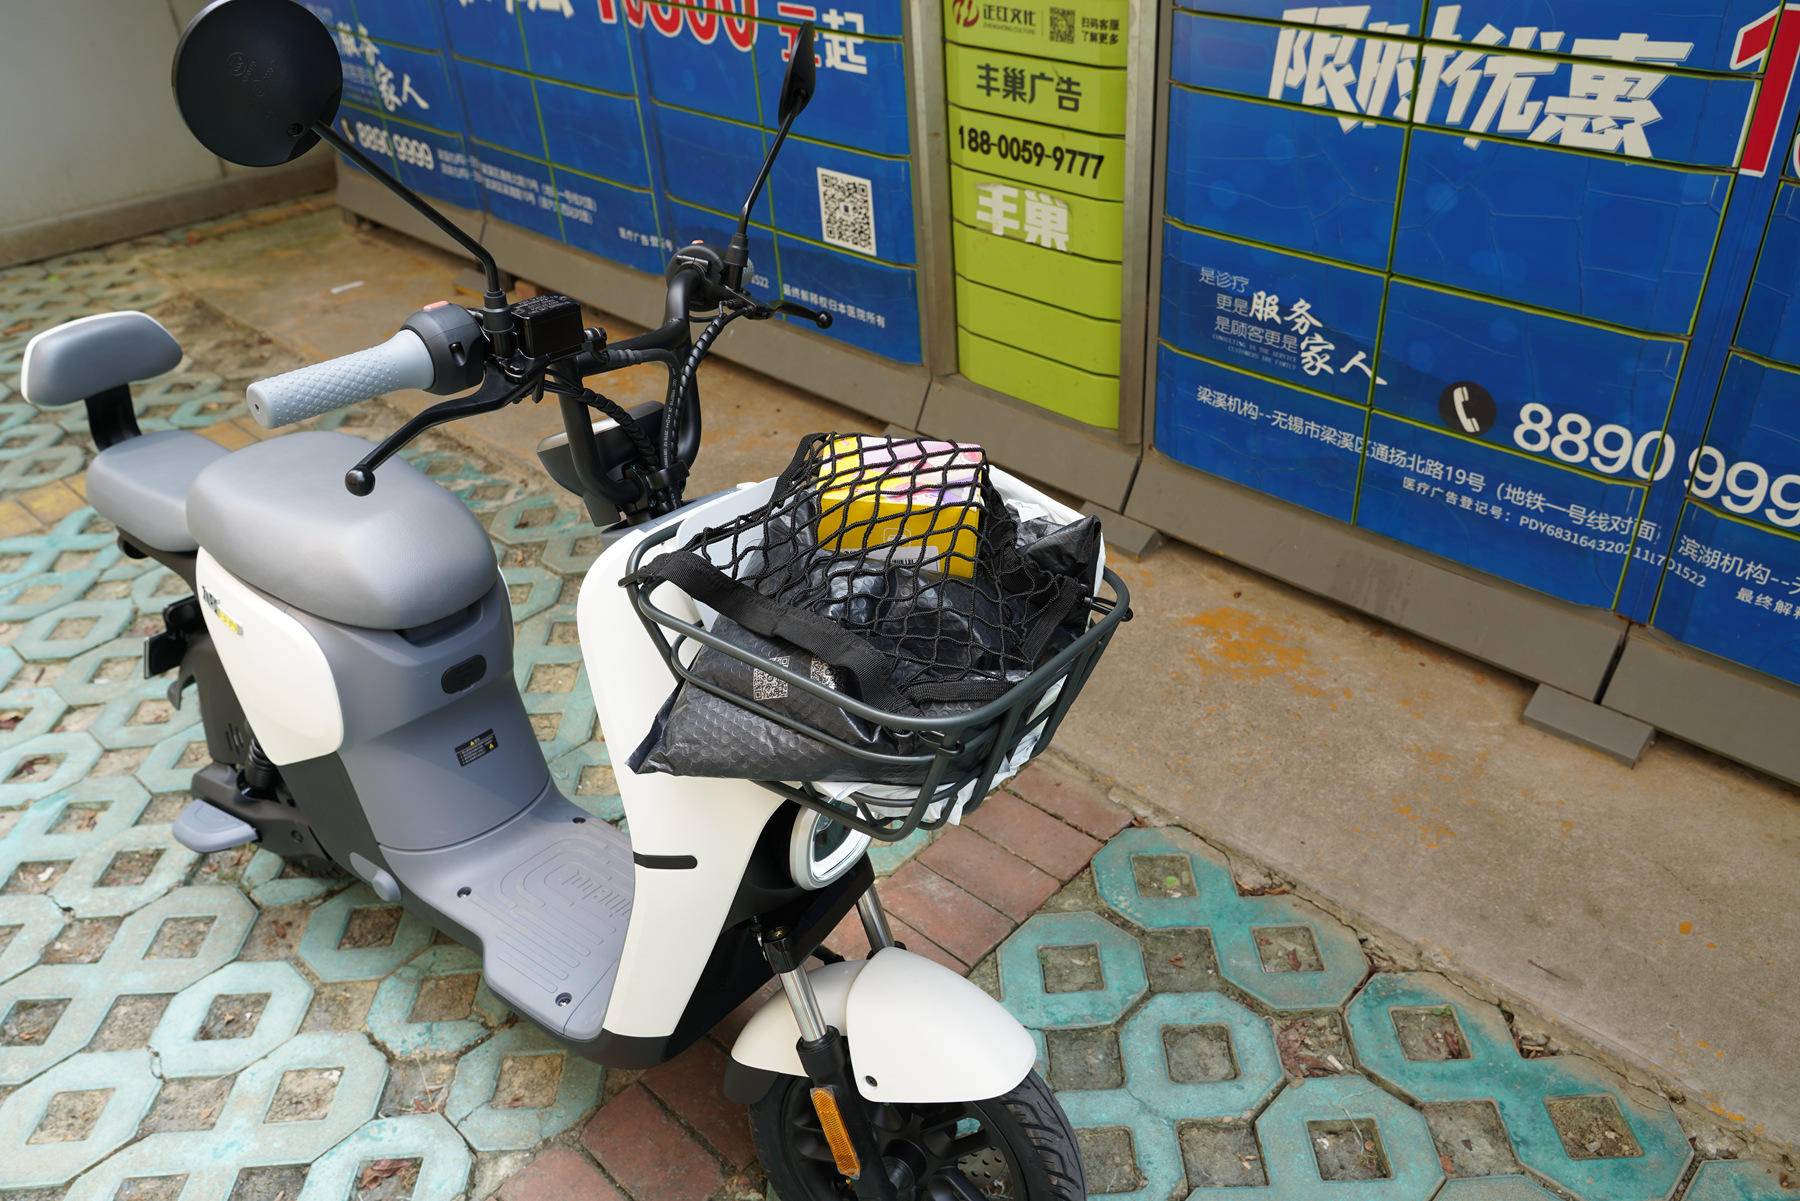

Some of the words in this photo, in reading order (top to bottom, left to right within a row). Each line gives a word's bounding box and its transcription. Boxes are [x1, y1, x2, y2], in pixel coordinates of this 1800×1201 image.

[1081, 17, 1120, 31] 扫码客服
[1081, 30, 1119, 45] 了解更多
[976, 63, 1082, 112] 丰巢广告
[1268, 4, 1695, 165] 限时优惠
[1729, 3, 1800, 178] 1
[958, 126, 1105, 179] 188-0059-9777
[976, 184, 1070, 251] 丰巢
[1200, 267, 1250, 293] 是诊疗
[1216, 293, 1249, 317] 更是
[1214, 315, 1298, 353] 是顾客更是
[1299, 333, 1388, 386] 家人
[1513, 402, 1676, 481] 8890
